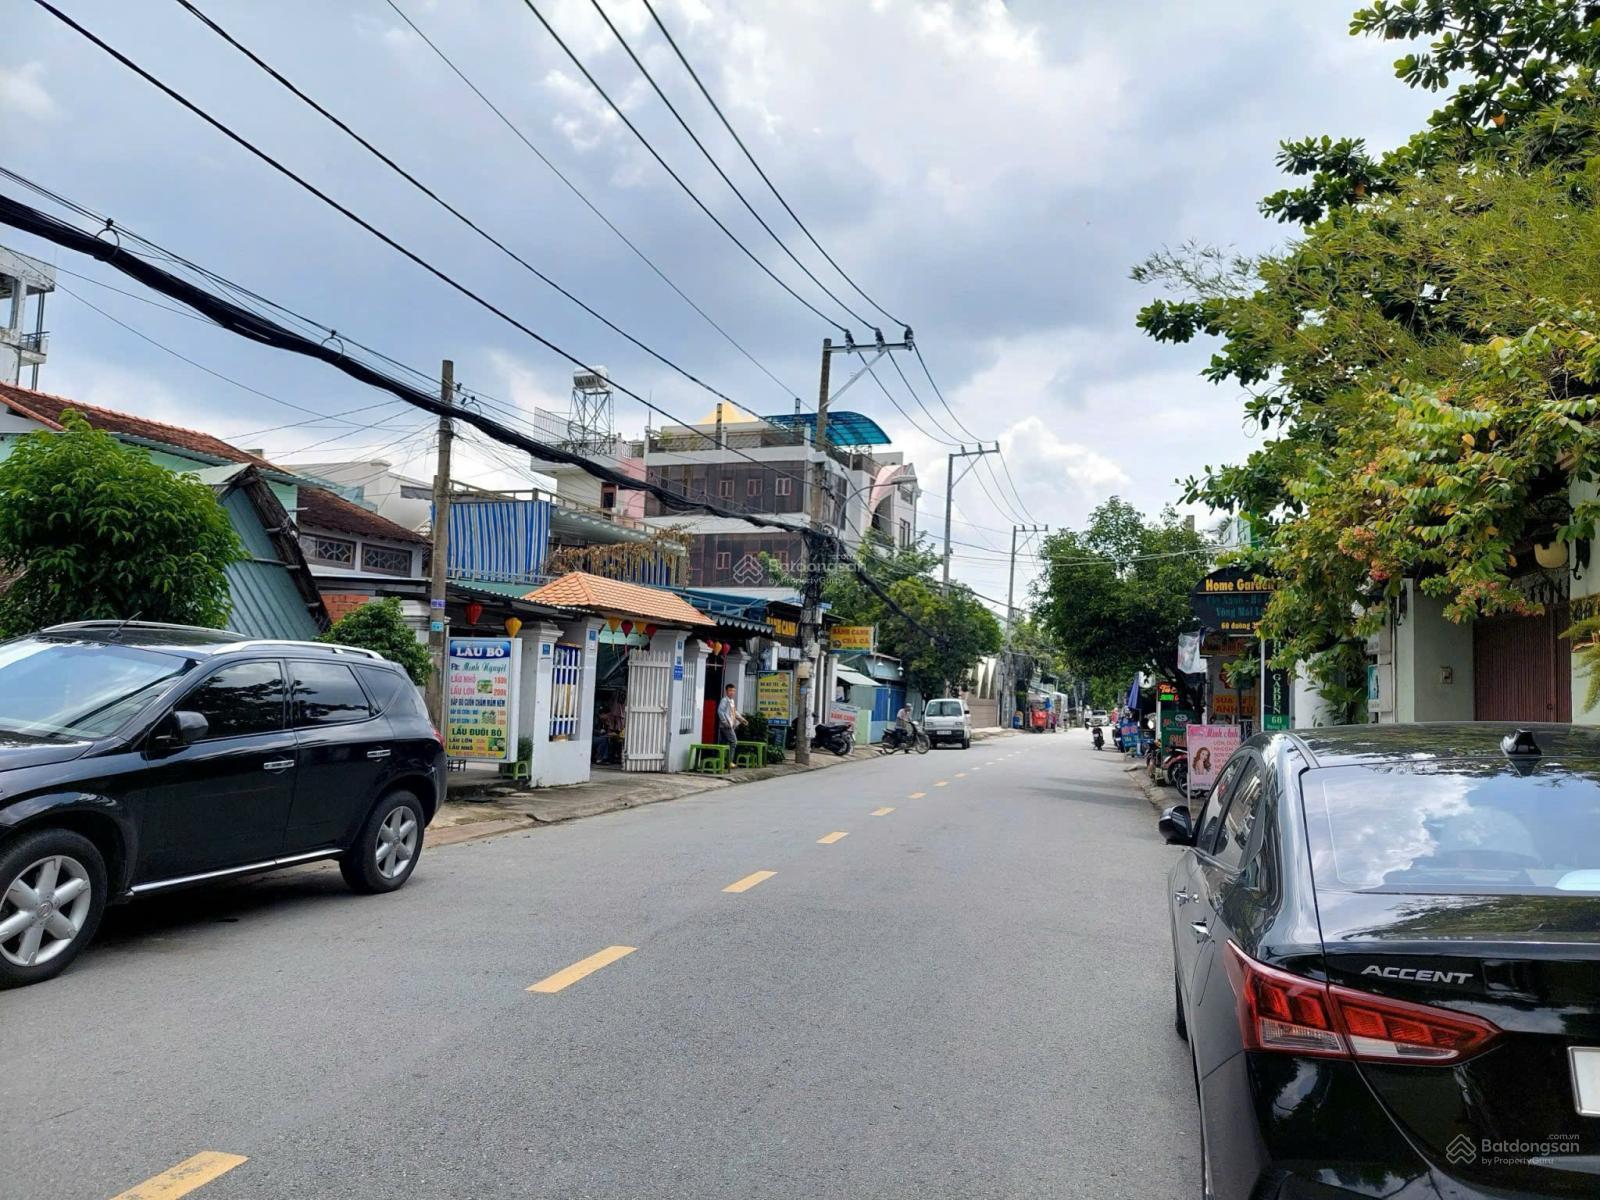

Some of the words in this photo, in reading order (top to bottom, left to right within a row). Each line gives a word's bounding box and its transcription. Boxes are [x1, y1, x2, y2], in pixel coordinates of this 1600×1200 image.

[1205, 579, 1233, 591] Home
[1272, 673, 1283, 714] GARDEN
[1361, 965, 1473, 984] ACCENT
